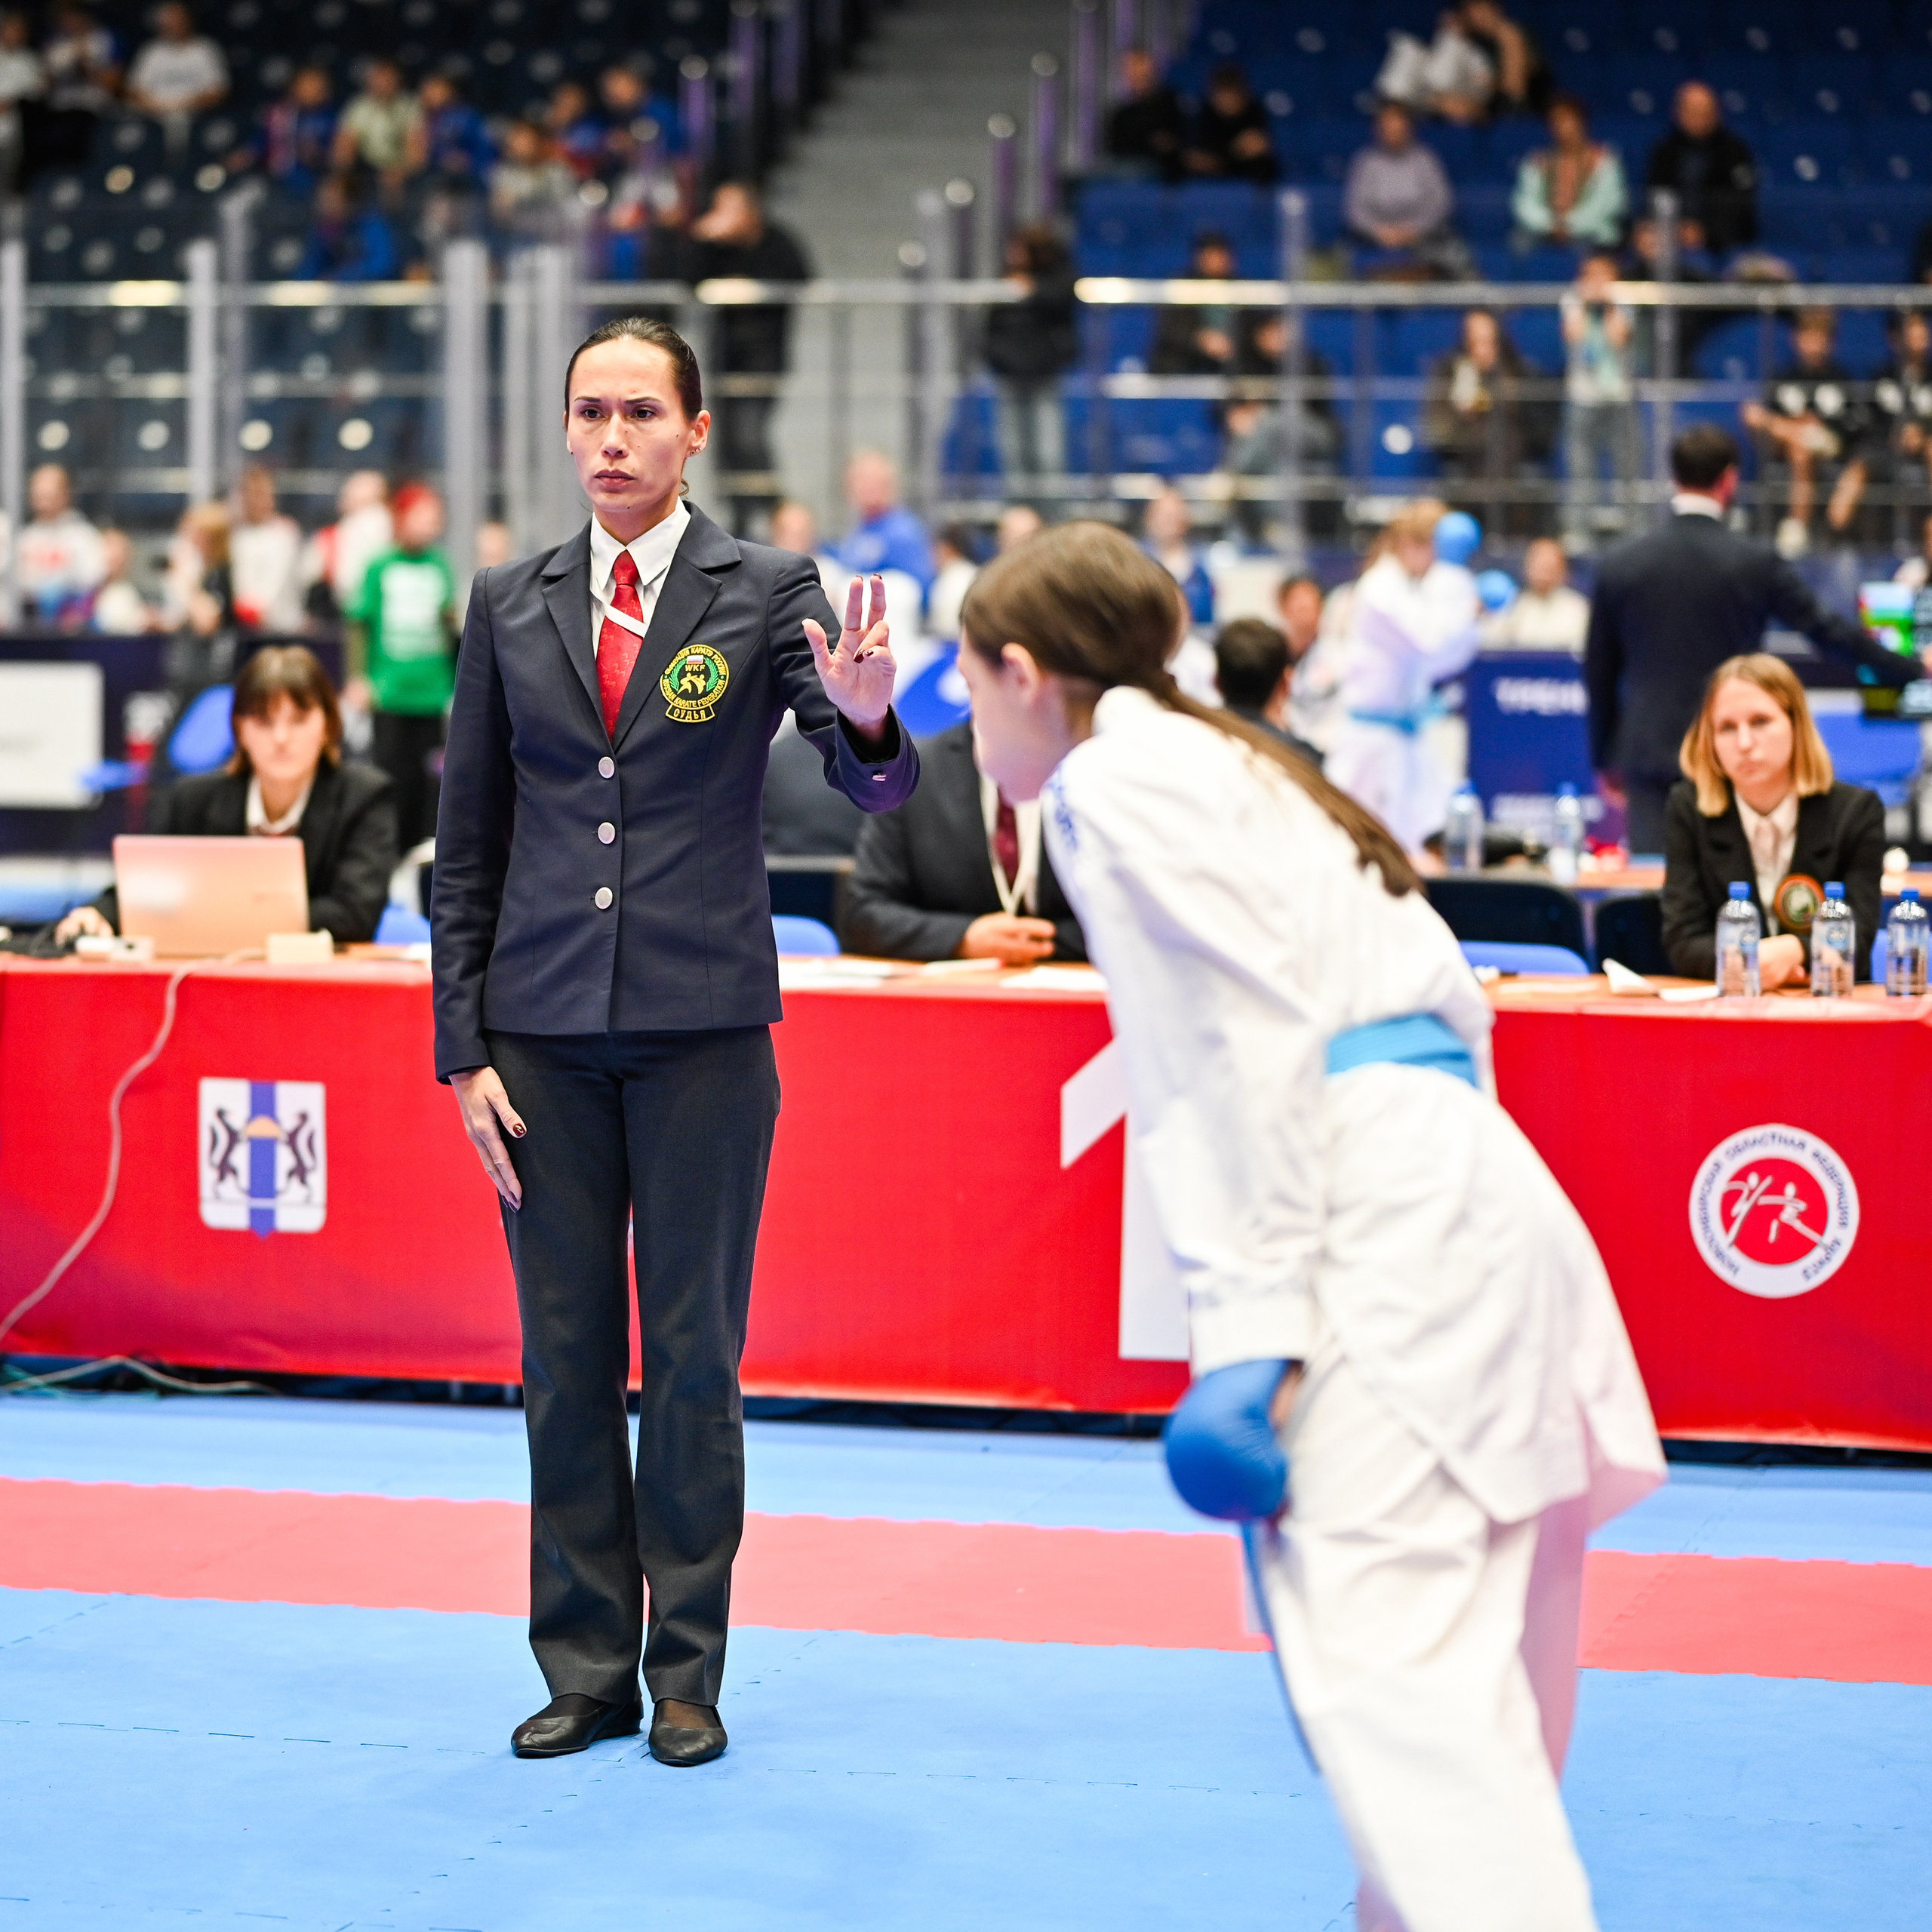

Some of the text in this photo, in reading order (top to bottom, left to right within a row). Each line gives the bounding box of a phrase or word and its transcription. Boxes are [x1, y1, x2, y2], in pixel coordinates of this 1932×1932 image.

[691, 647, 714, 657] КАРАТЭ
[711, 654, 727, 675] РОССИИ
[663, 679, 726, 708] RUSSIAN KARATE FEDERATION
[673, 709, 706, 721] СУДЬЯ
